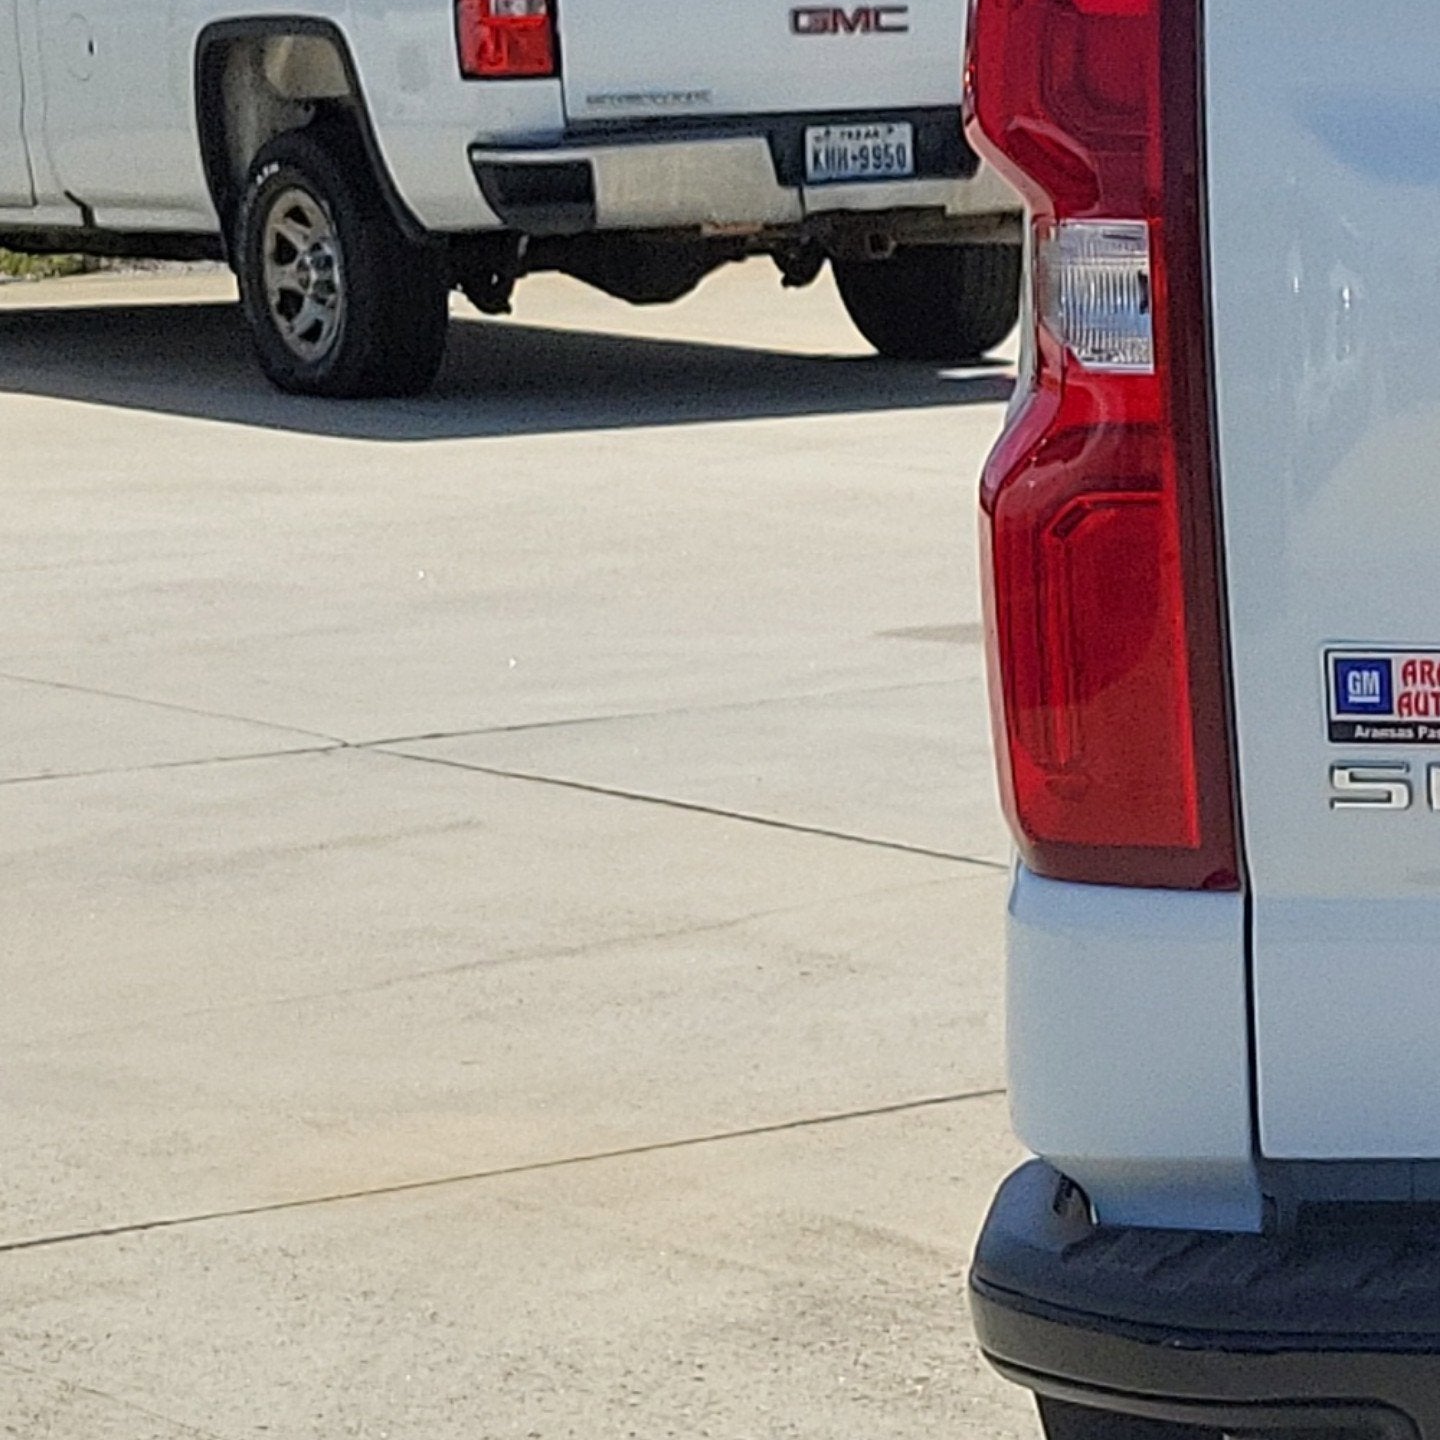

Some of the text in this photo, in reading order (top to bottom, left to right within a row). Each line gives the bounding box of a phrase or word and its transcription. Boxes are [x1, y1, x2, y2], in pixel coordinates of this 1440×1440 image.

[790, 6, 909, 35] GMC
[1347, 670, 1381, 696] GM
[1354, 724, 1414, 740] Aransas
